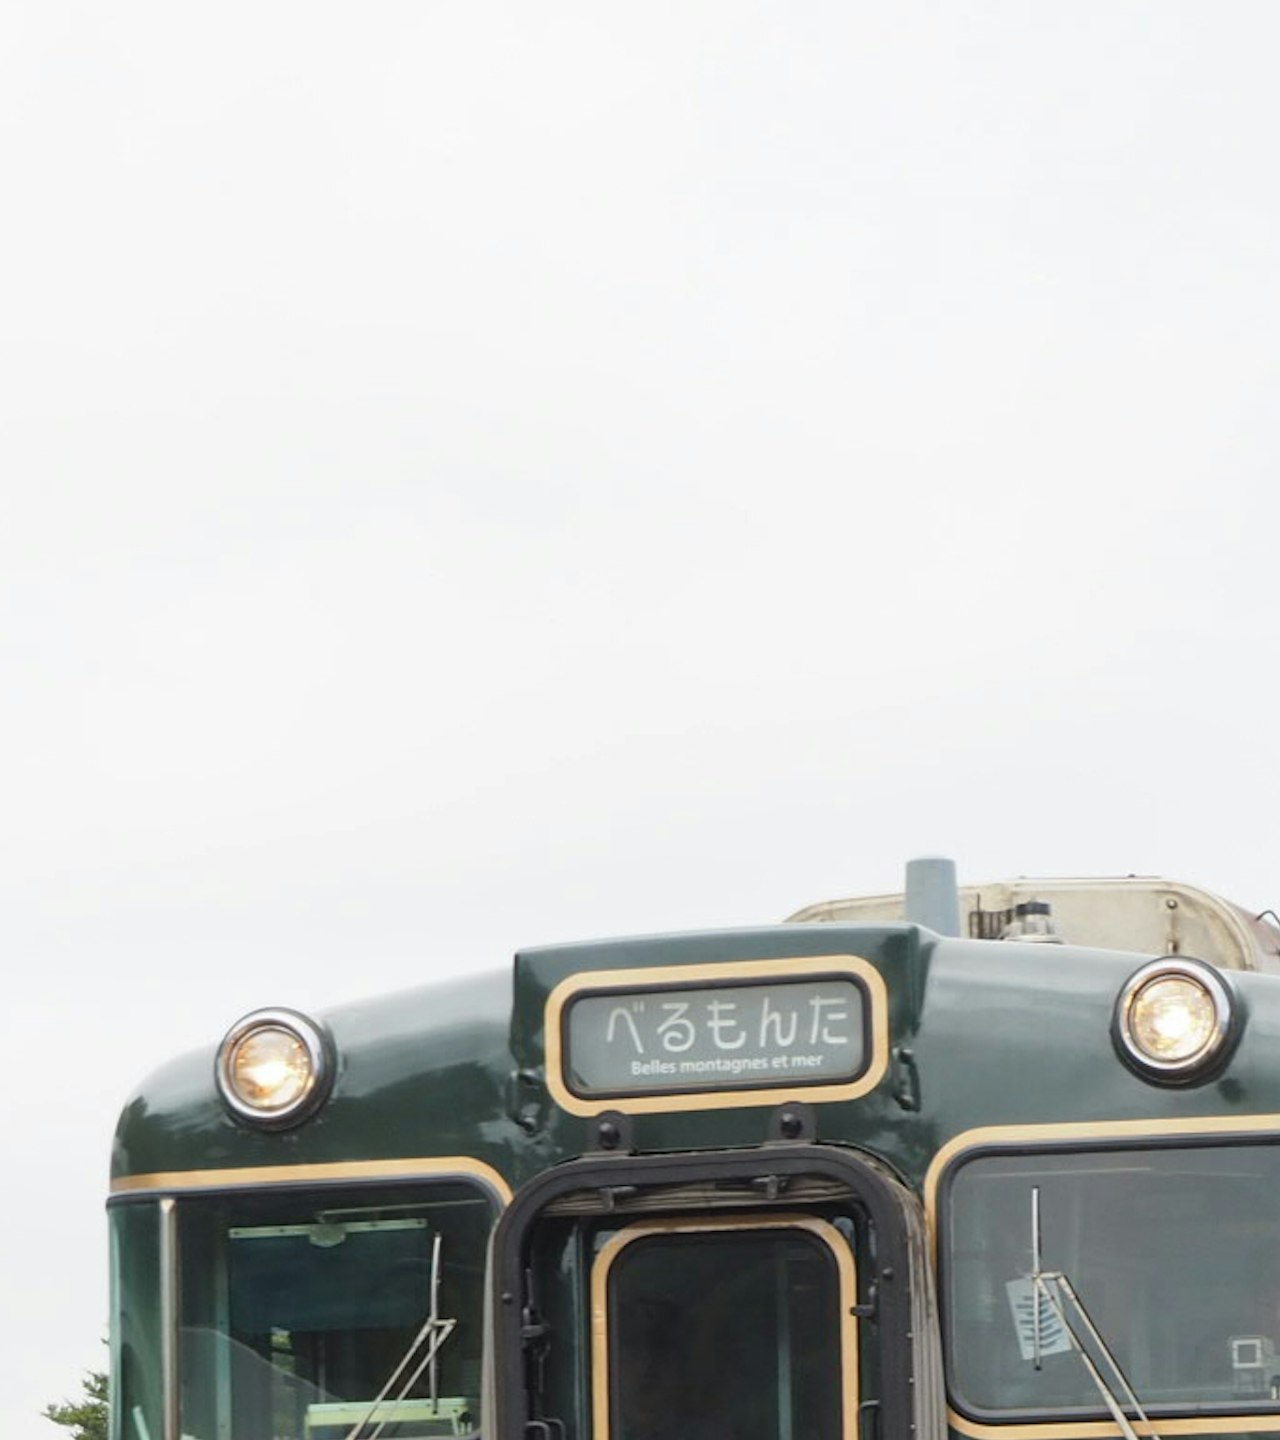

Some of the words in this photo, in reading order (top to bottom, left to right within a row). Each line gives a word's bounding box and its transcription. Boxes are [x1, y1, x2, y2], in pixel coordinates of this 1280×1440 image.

[606, 995, 849, 1053] べるもんた
[631, 1058, 676, 1076] Belles
[679, 1056, 769, 1075] montagnes
[772, 1055, 789, 1070] et
[791, 1053, 824, 1068] mer
